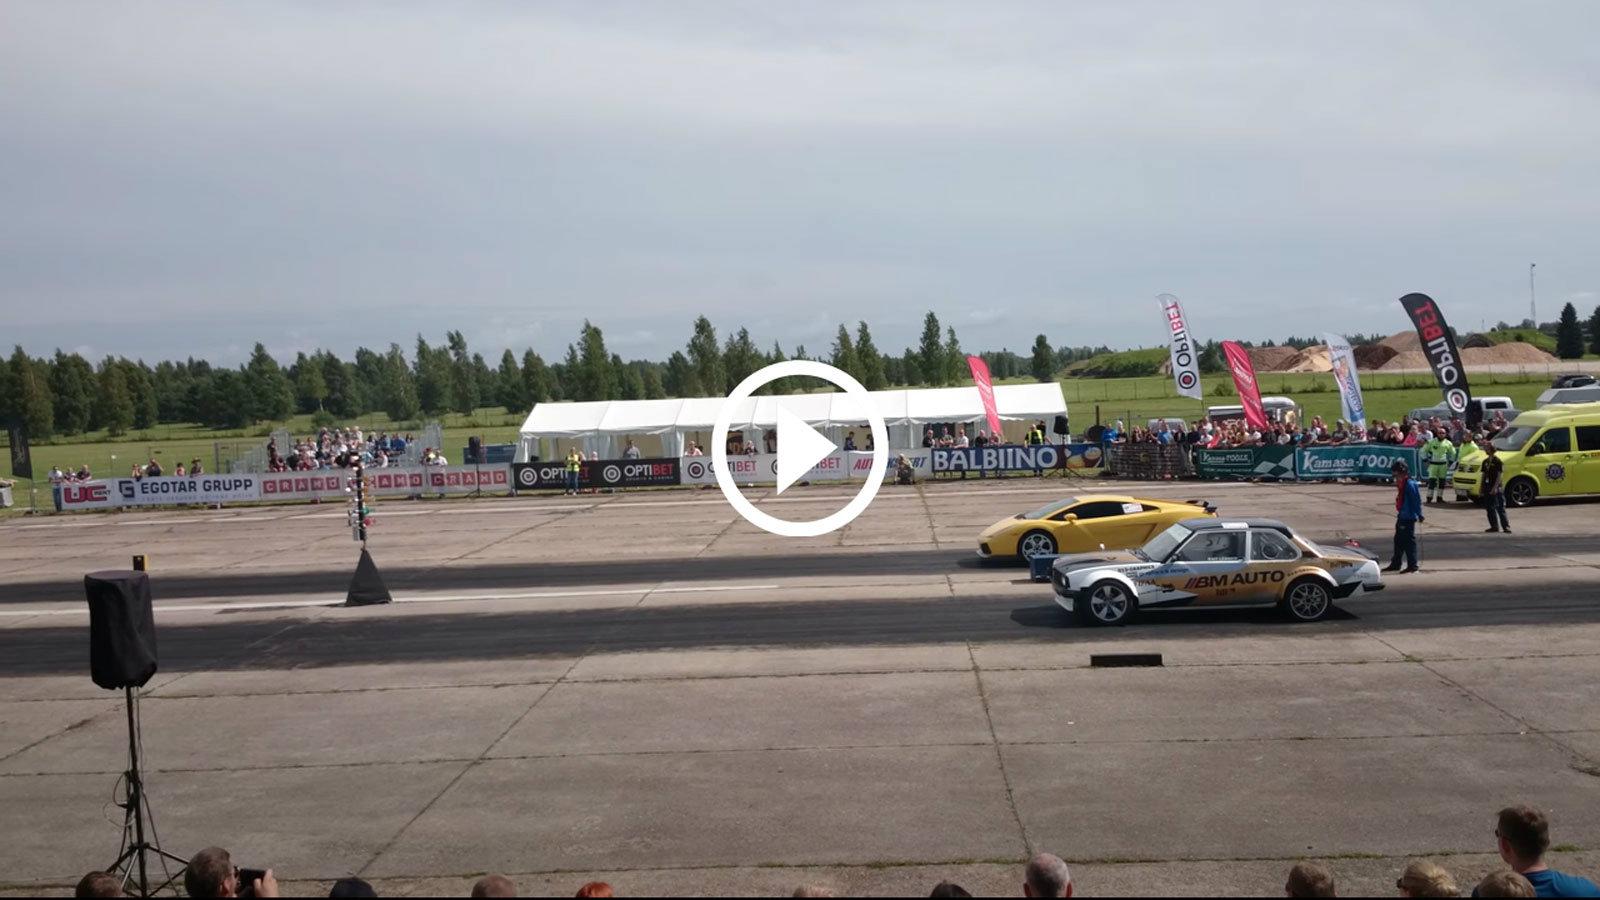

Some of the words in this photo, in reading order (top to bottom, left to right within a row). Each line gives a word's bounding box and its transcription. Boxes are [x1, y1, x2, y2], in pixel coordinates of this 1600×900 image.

[934, 447, 1058, 470] BALBIINO
[624, 463, 673, 477] OPTIBET
[263, 476, 340, 493] CRAMO
[432, 470, 506, 486] CRAMO
[141, 481, 197, 494] EGOTAR
[203, 479, 253, 492] GRUPP
[1231, 571, 1285, 585] AUTO
